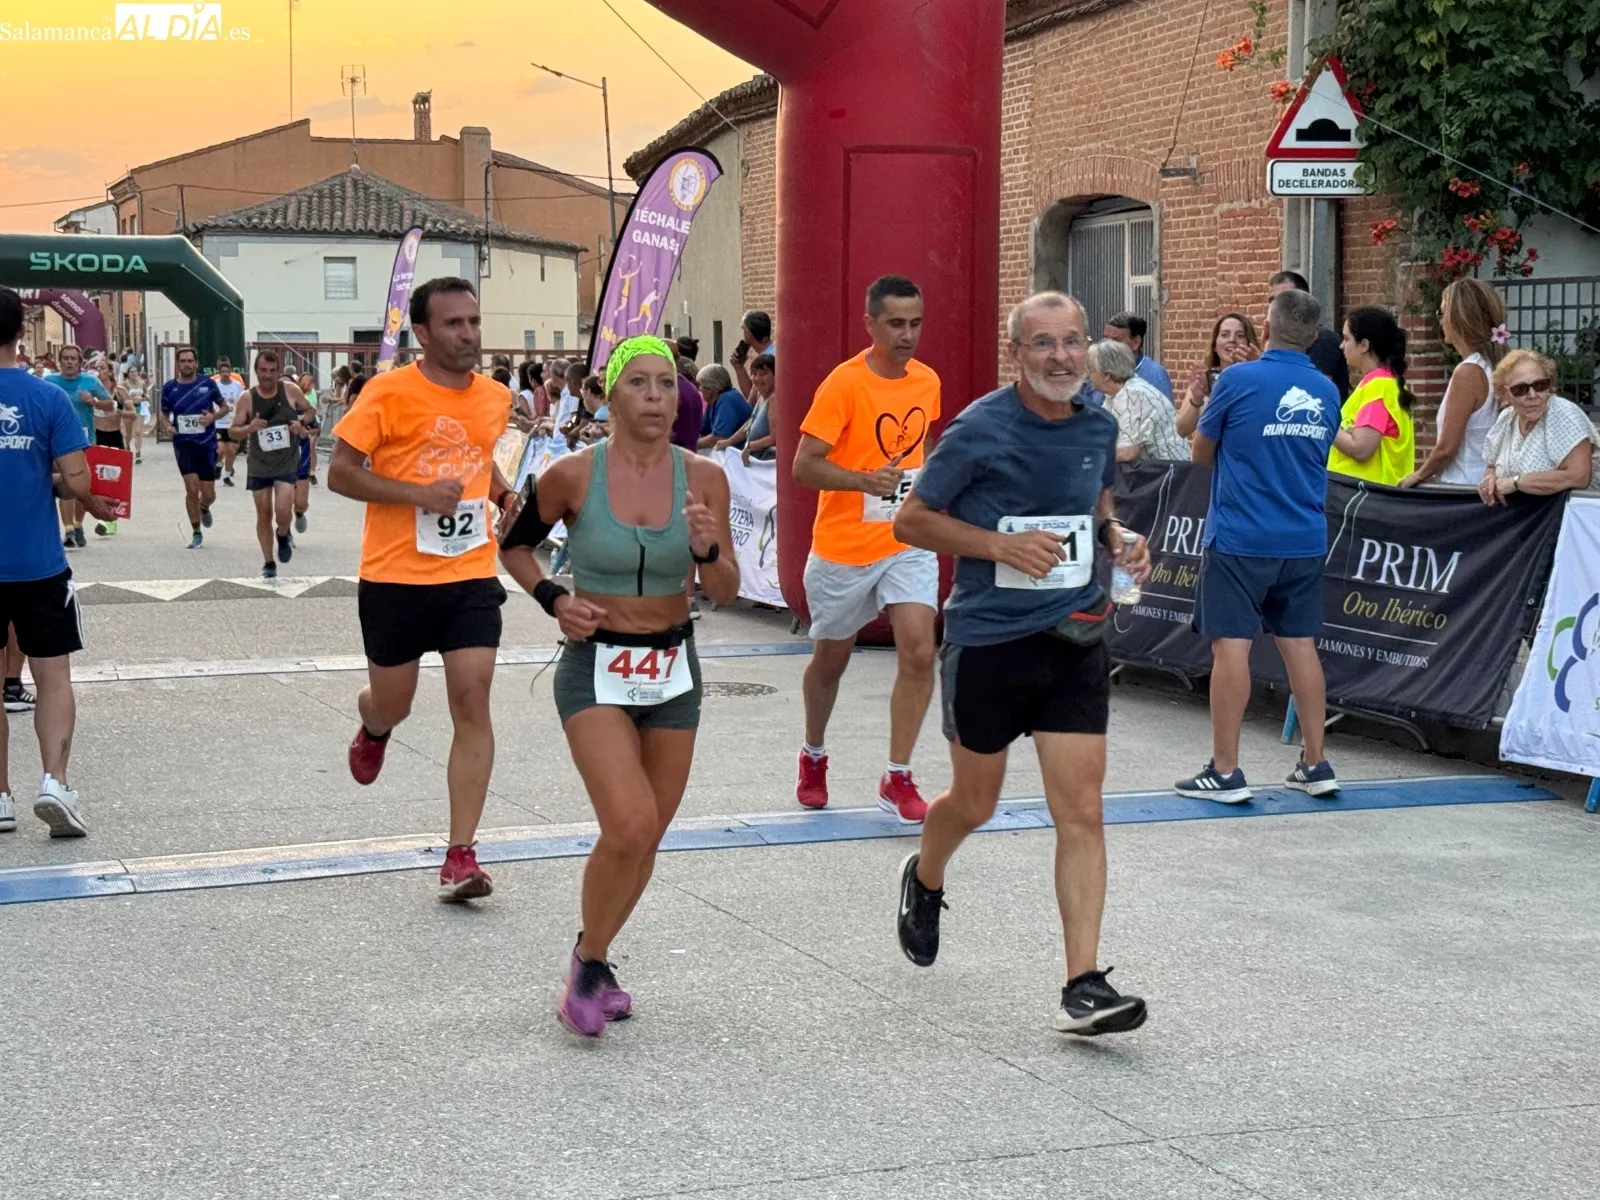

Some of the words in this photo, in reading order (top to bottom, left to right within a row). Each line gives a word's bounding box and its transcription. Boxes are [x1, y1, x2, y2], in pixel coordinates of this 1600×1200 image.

[1302, 168, 1346, 177] BANDAS
[266, 430, 283, 443] 33
[437, 513, 474, 538] 92
[1160, 515, 1205, 556] PRI
[1150, 562, 1172, 583] Oro
[1173, 565, 1199, 588] Ibér
[1351, 537, 1464, 594] PRIM
[1343, 590, 1379, 618] Oro
[1381, 597, 1448, 630] Ibérico
[607, 648, 679, 680] 447
[1317, 637, 1366, 659] JAMONES
[1366, 647, 1376, 660] Y
[1376, 649, 1430, 669] EMBUTIDOS
